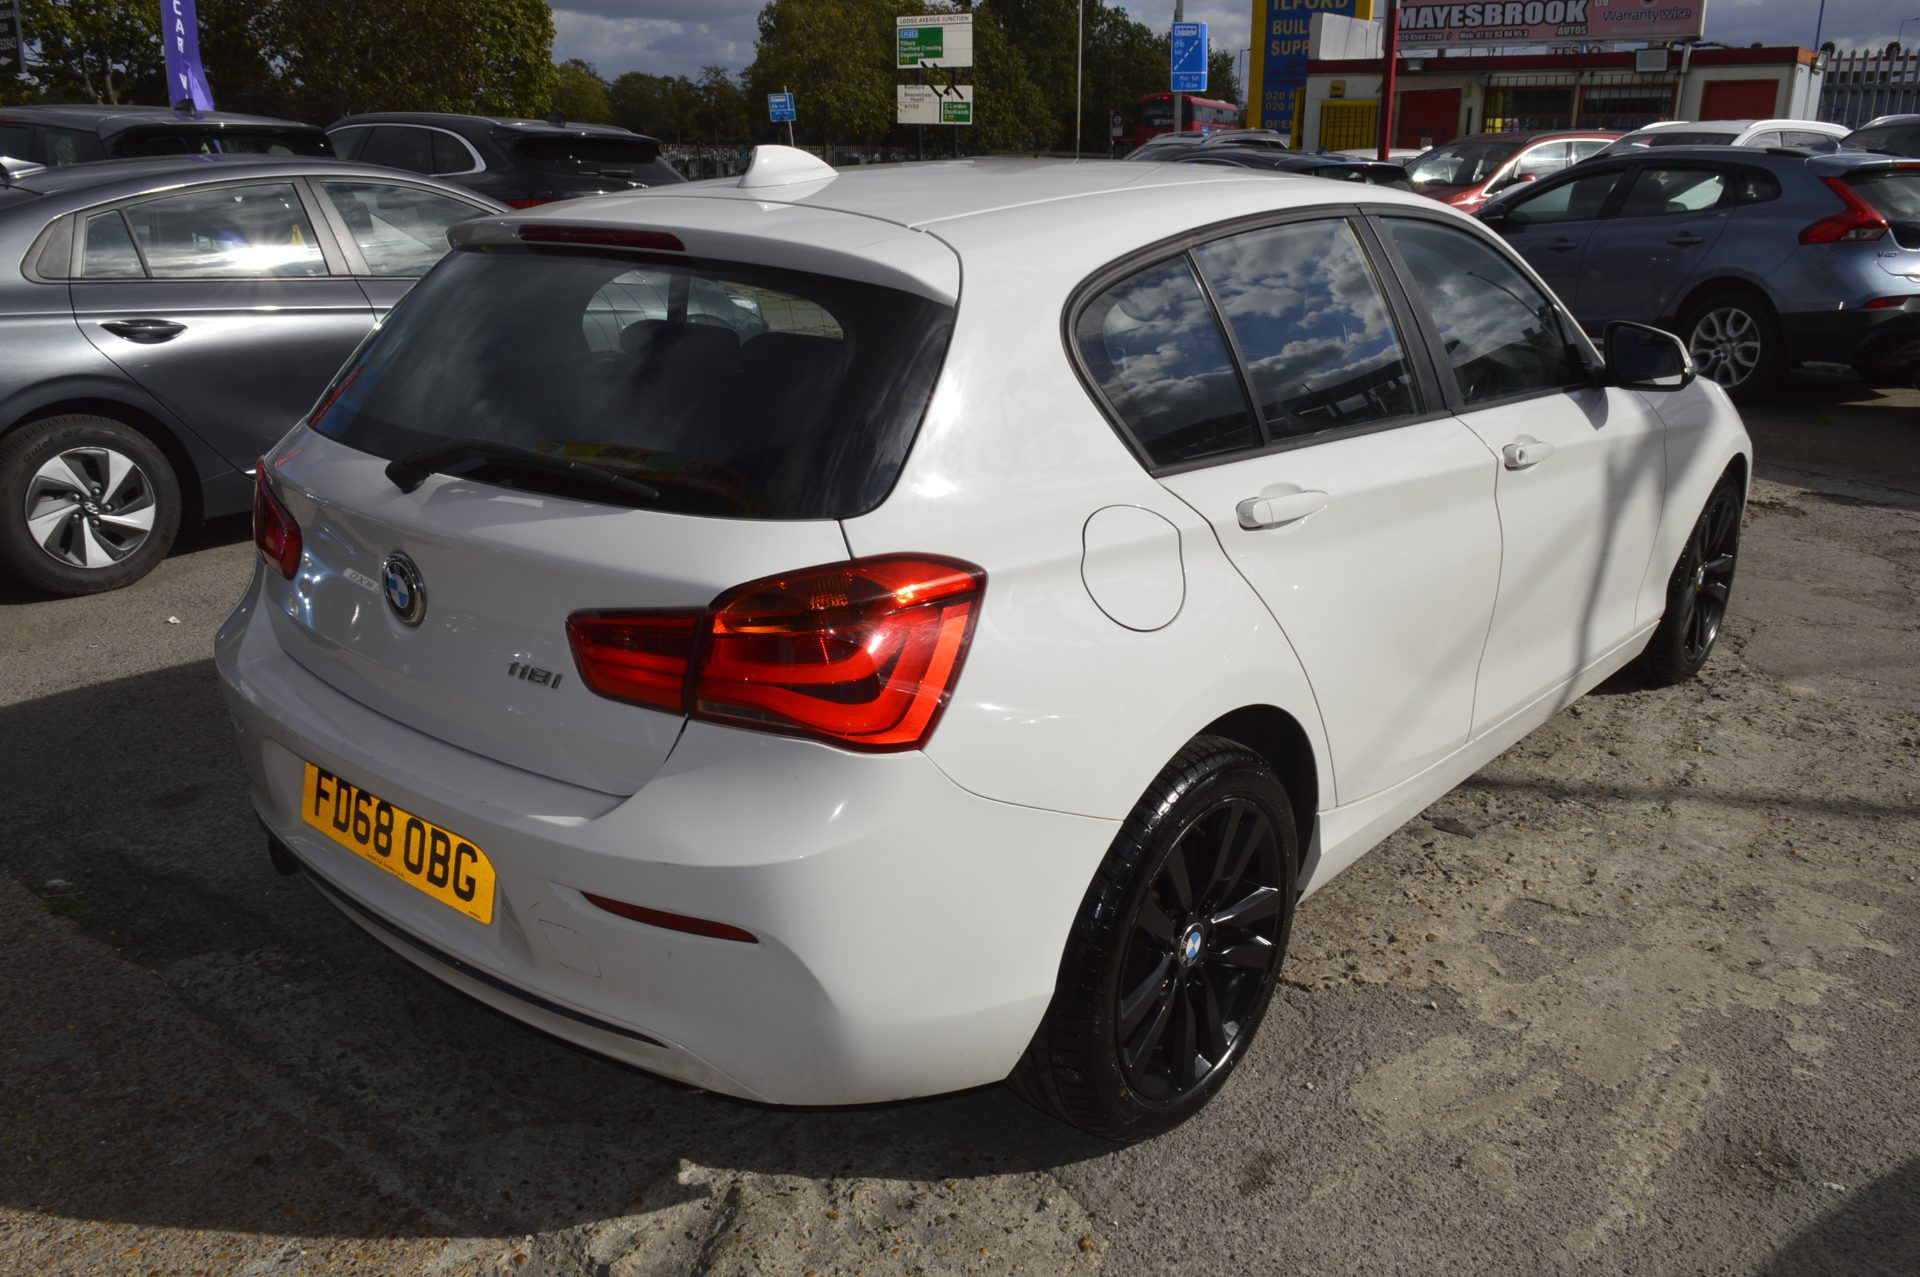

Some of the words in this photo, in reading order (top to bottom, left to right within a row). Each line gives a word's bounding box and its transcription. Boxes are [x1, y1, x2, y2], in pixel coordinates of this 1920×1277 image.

[1399, 0, 1588, 29] MAYESBROOK
[1272, 19, 1312, 35] BUIL
[1557, 25, 1587, 35] AUTOS
[1271, 40, 1309, 56] SUPP
[1551, 45, 1601, 55] TESO
[314, 767, 394, 858] FD68
[403, 816, 478, 902] OBG
